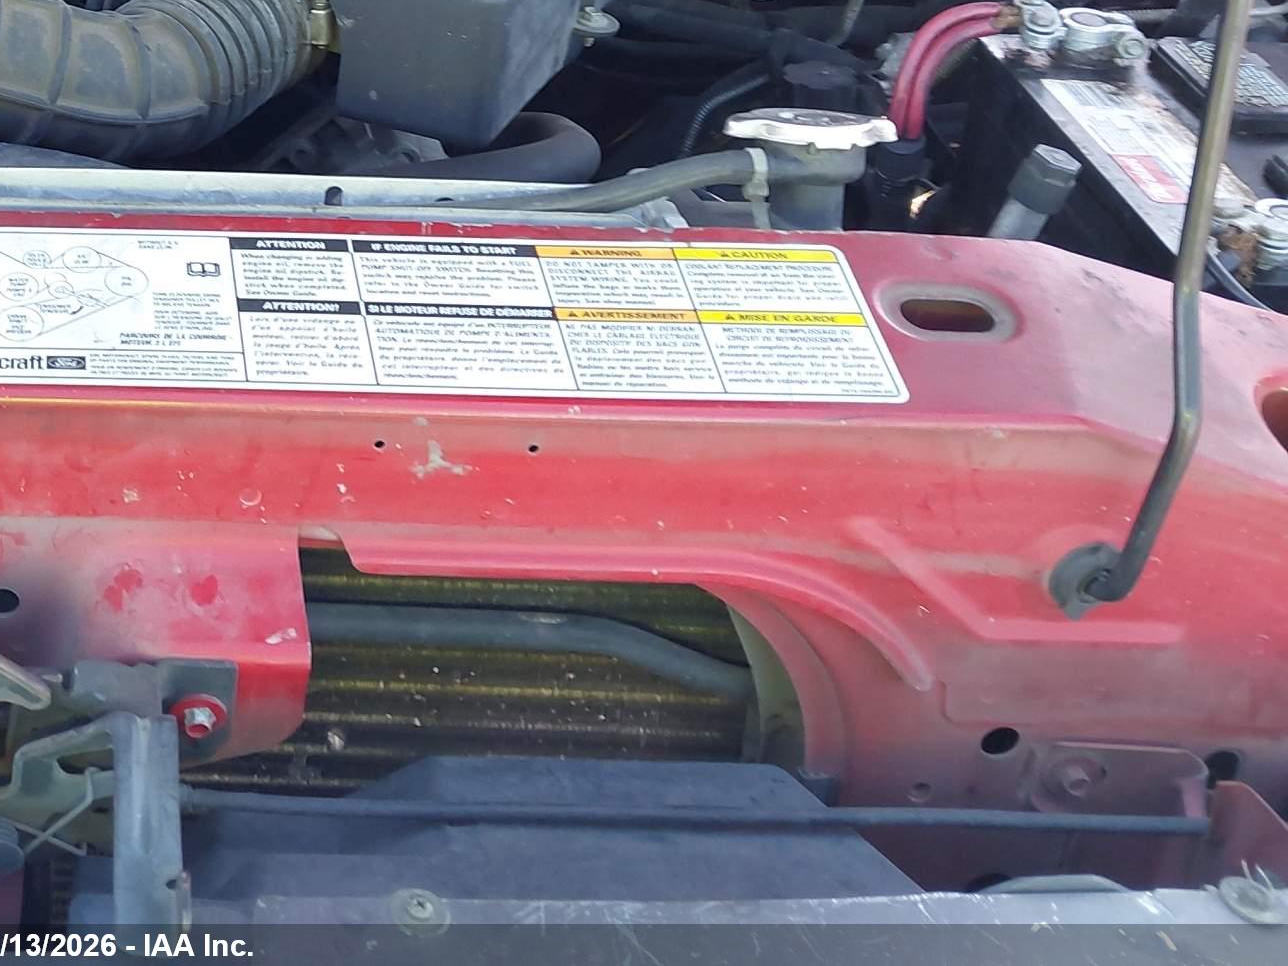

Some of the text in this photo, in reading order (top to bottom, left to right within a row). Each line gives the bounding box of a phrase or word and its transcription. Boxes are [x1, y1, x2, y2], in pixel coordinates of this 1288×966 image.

[256, 240, 326, 250] ATTENTION
[370, 243, 518, 255] IF ENGINE FAILS TO START
[730, 251, 788, 259] CAUTION
[368, 304, 380, 313] SI
[380, 305, 393, 314] LE
[394, 306, 438, 315] MOTEUR
[439, 307, 478, 316] REFUSE
[480, 308, 494, 316] DE
[583, 312, 687, 320] AVERTISSEMENT
[794, 315, 836, 323] GARDE
